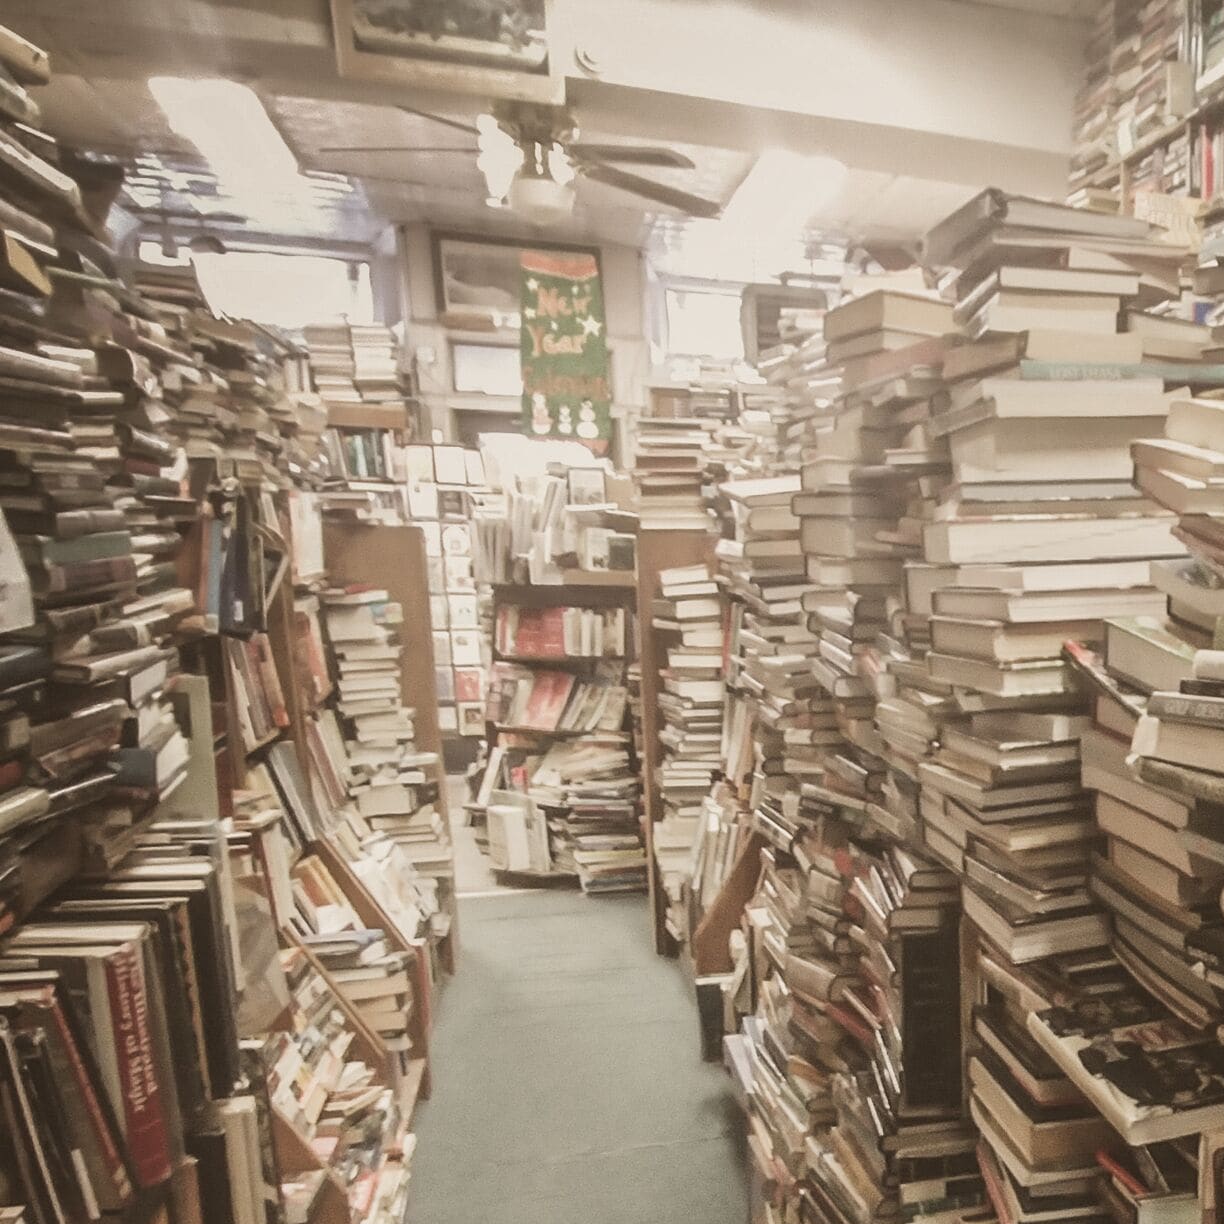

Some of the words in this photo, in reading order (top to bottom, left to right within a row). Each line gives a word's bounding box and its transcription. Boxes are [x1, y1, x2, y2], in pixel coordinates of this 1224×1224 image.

[536, 286, 594, 318] New
[526, 322, 588, 358] Year
[126, 1034, 140, 1054] of
